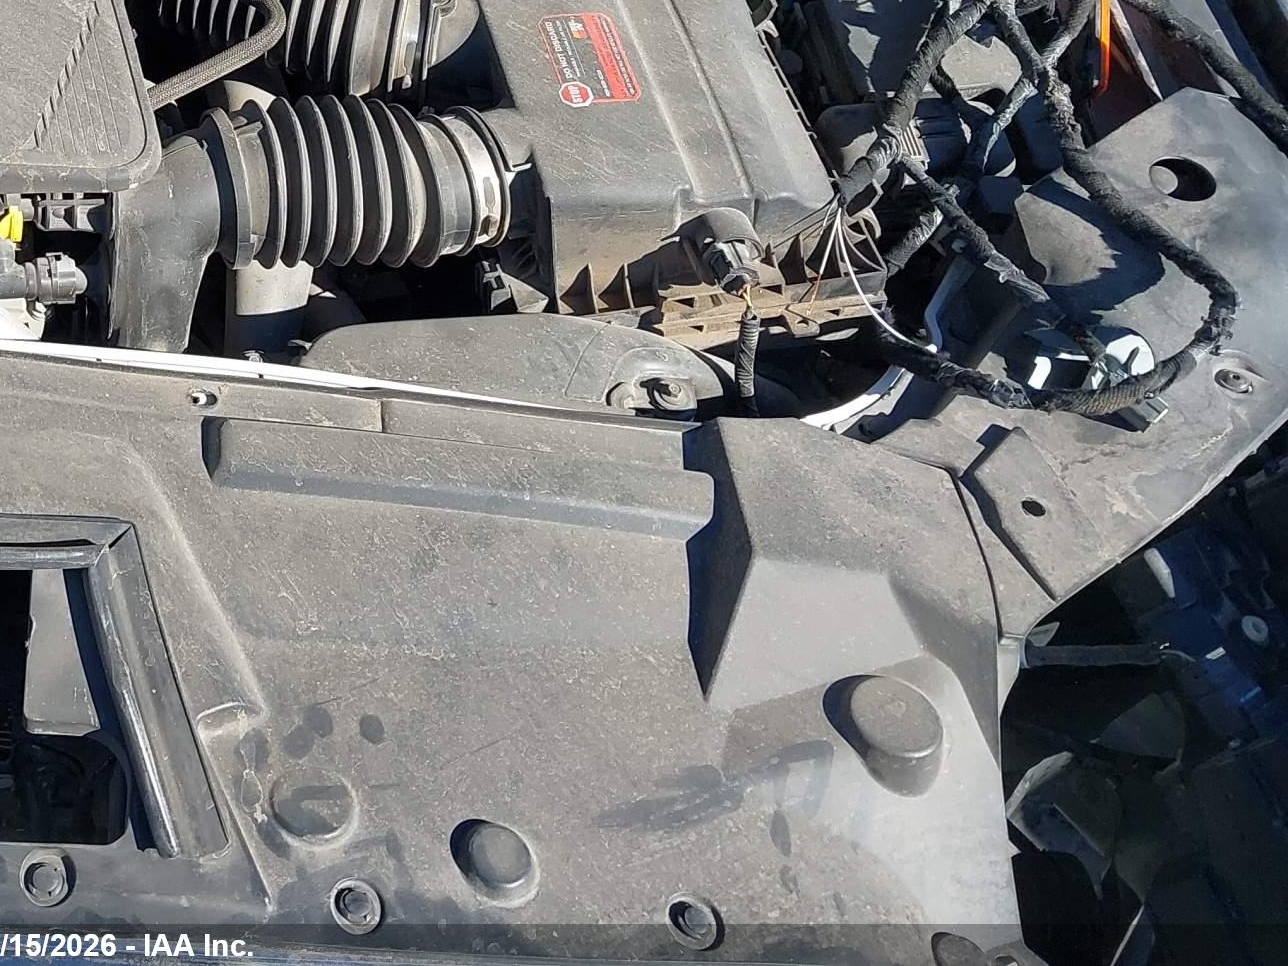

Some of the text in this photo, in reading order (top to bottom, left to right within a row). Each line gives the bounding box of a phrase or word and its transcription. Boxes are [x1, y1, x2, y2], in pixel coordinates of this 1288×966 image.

[545, 21, 562, 52] DISCARD
[557, 53, 569, 68] NOT
[563, 68, 573, 79] DO
[567, 85, 584, 103] STOP
